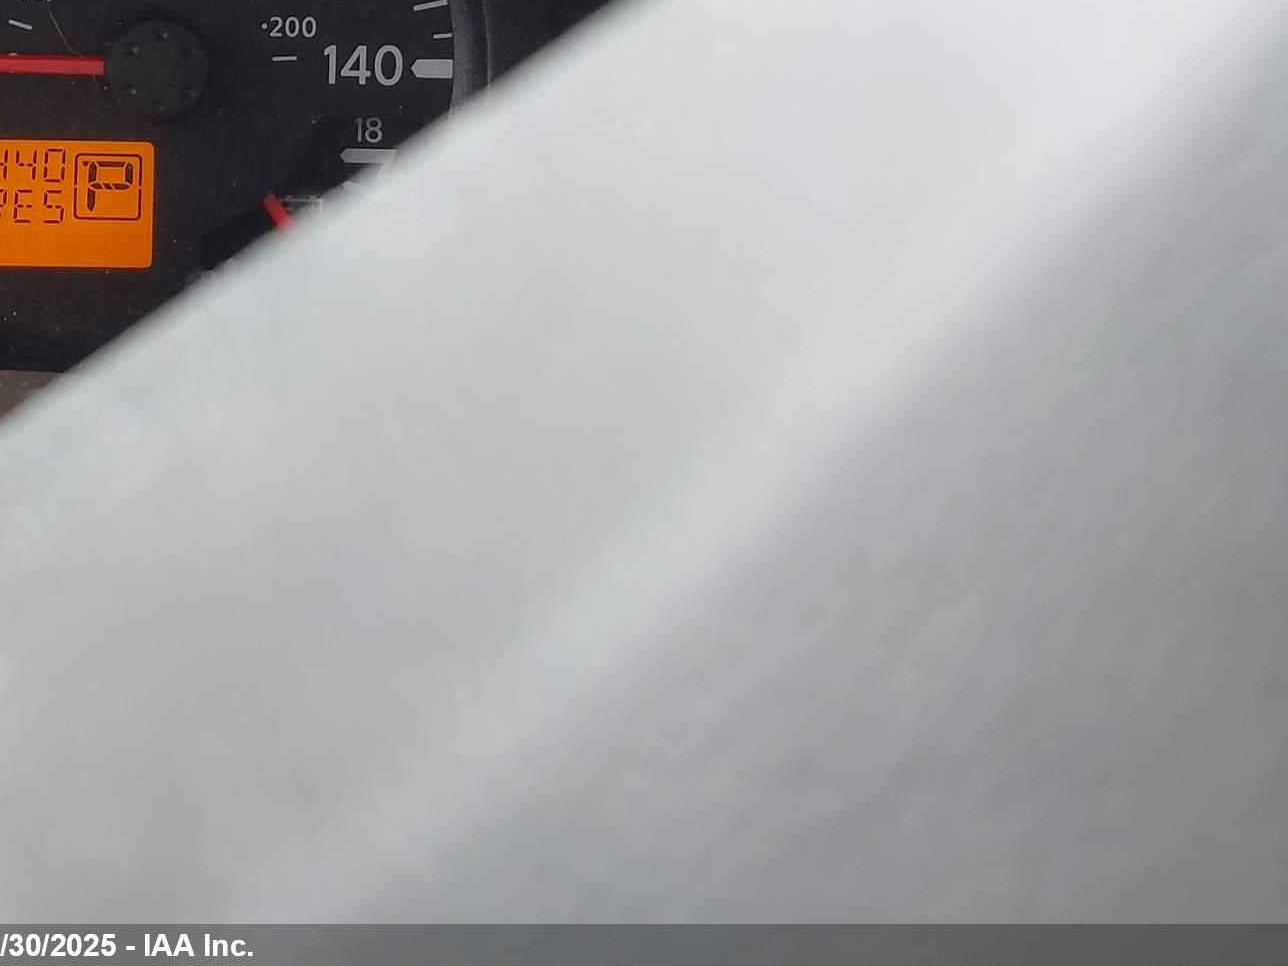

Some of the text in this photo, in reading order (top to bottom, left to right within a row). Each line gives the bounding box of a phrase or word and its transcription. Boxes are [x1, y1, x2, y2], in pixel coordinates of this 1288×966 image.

[269, 16, 317, 38] 200
[323, 44, 403, 86] 140
[355, 118, 383, 144] 18
[82, 161, 134, 212] P
